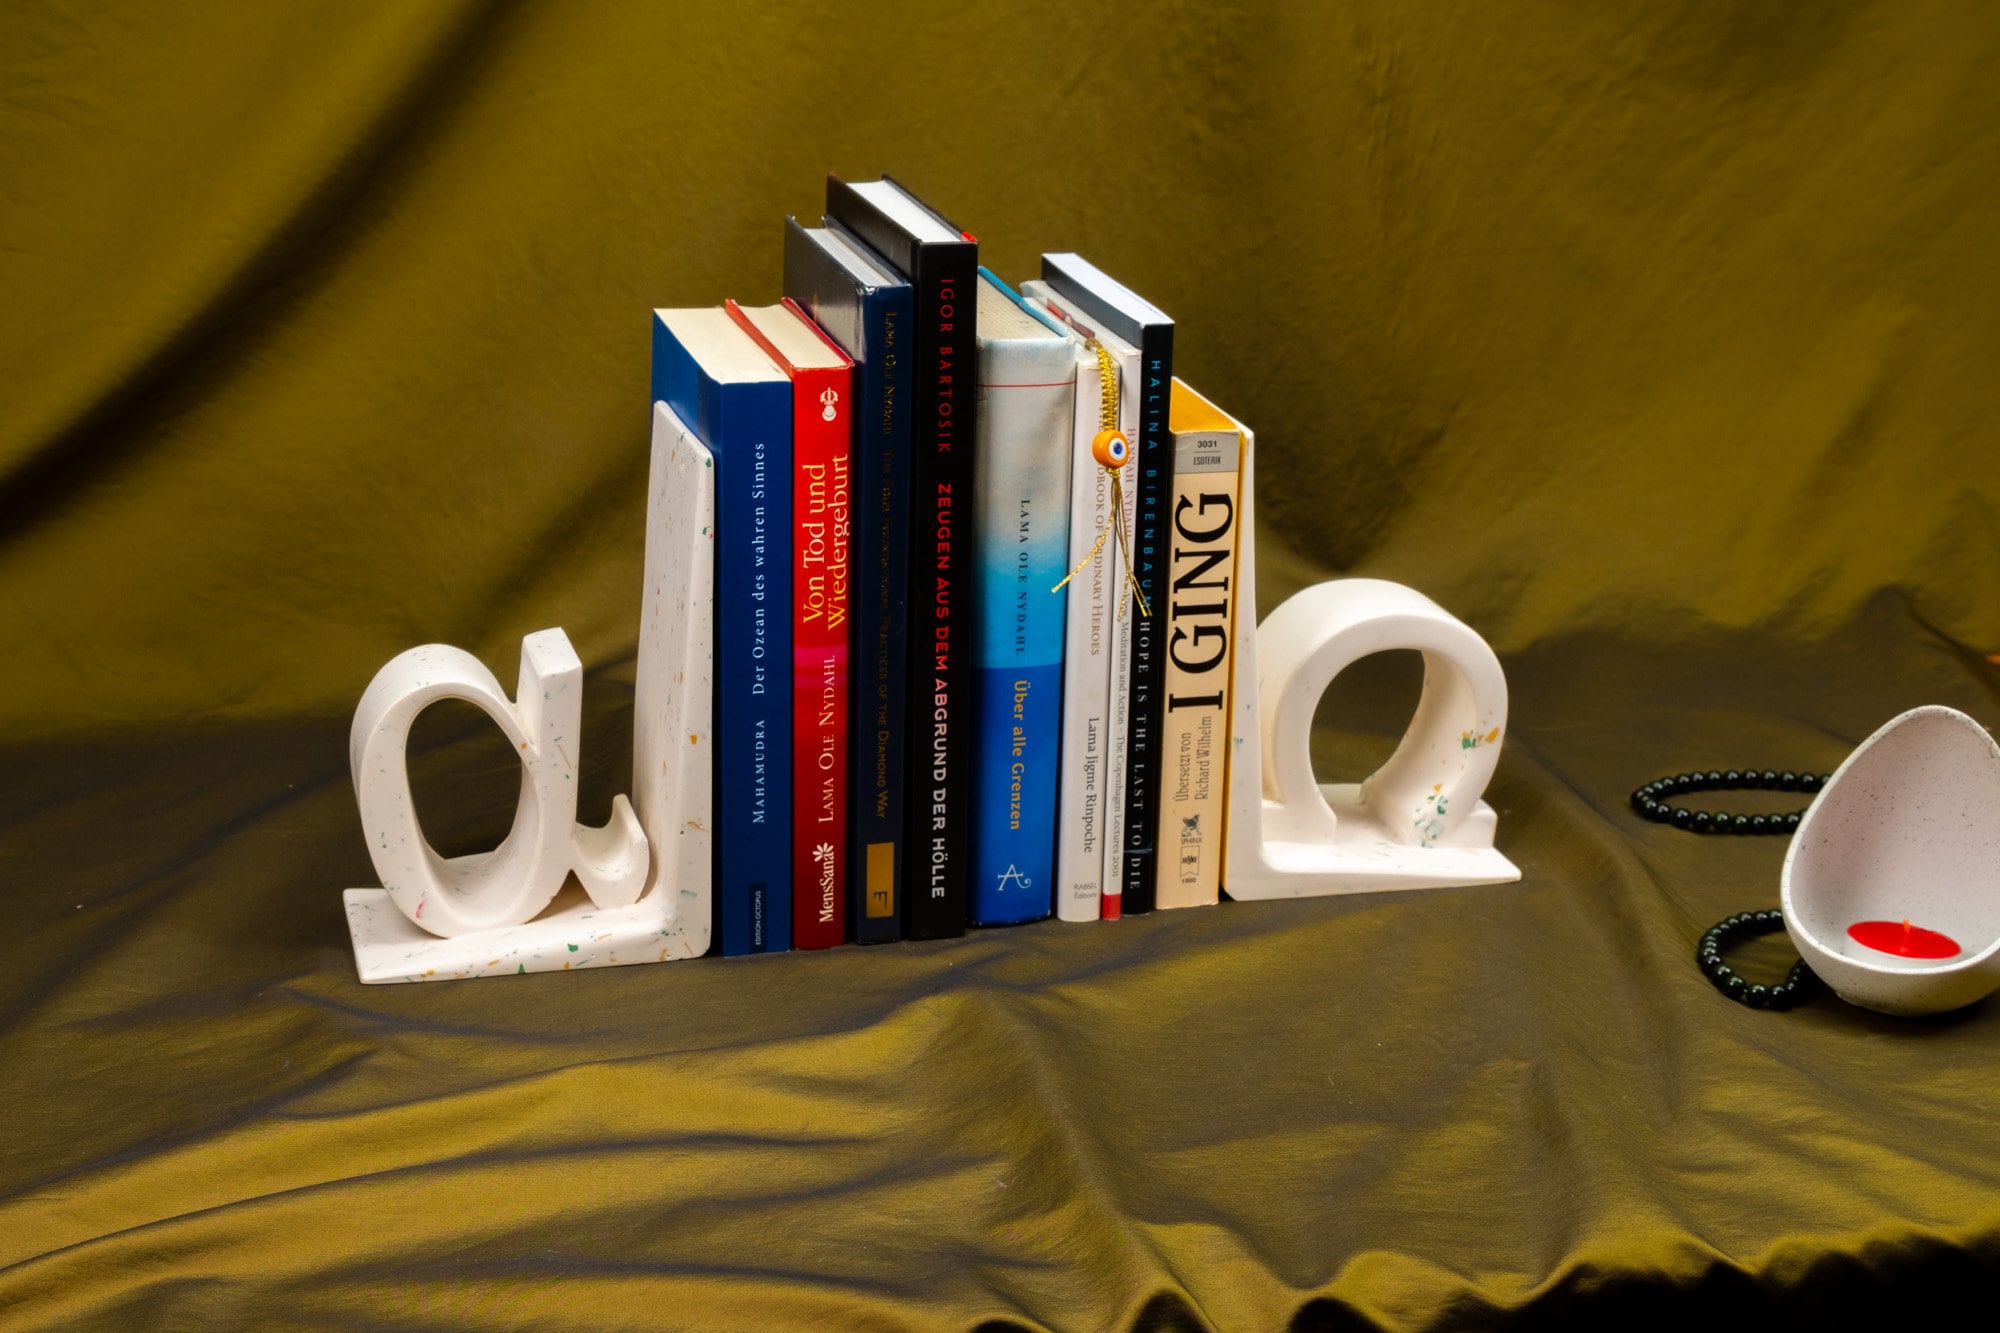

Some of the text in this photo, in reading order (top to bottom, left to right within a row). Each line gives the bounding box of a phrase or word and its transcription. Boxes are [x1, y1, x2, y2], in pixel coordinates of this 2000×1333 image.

[1148, 360, 1162, 450] HALINA
[1193, 456, 1222, 466] ESOTERIK
[1197, 440, 1218, 449] 3031
[802, 463, 826, 623] Von Tod und
[828, 454, 850, 630] Wiedergeburt
[1095, 514, 1105, 531] OF
[931, 278, 954, 898] IGOR BARTOSIK ZEUGEN AUS DEM ABGRUND DER HÖLLE
[1015, 499, 1031, 656] LAMA OLE NYDAHL
[1168, 493, 1234, 714] I GING
[752, 443, 765, 824] MAHAMUDRA Der Ozean des wahren Sinnes
[1090, 606, 1104, 656] HEROES
[1118, 621, 1130, 673] Meditation
[1138, 621, 1151, 673] HOPE
[1118, 674, 1128, 692] and
[1137, 685, 1148, 702] IS
[877, 703, 888, 726] THE
[1087, 717, 1100, 752] Lama
[1117, 694, 1127, 724] Action
[1135, 714, 1147, 752] THE
[818, 655, 835, 823] LAMA OLE NYDAHL
[876, 730, 890, 788] DIAMOND
[1010, 679, 1031, 830] Über alle Grenzen
[1116, 735, 1126, 753] The
[1195, 716, 1212, 801] Richard Wilhelm
[1083, 754, 1098, 790] Jigme
[1112, 755, 1125, 813] Copenhagen
[1132, 763, 1145, 810] LAST
[1173, 732, 1191, 802] Übersetzt von
[875, 790, 889, 818] WAY
[1082, 794, 1098, 853] Rinpoche
[1111, 814, 1122, 855] Lectures
[1131, 821, 1143, 846] TO
[819, 849, 834, 923] MensSana
[1130, 857, 1141, 889] DIE
